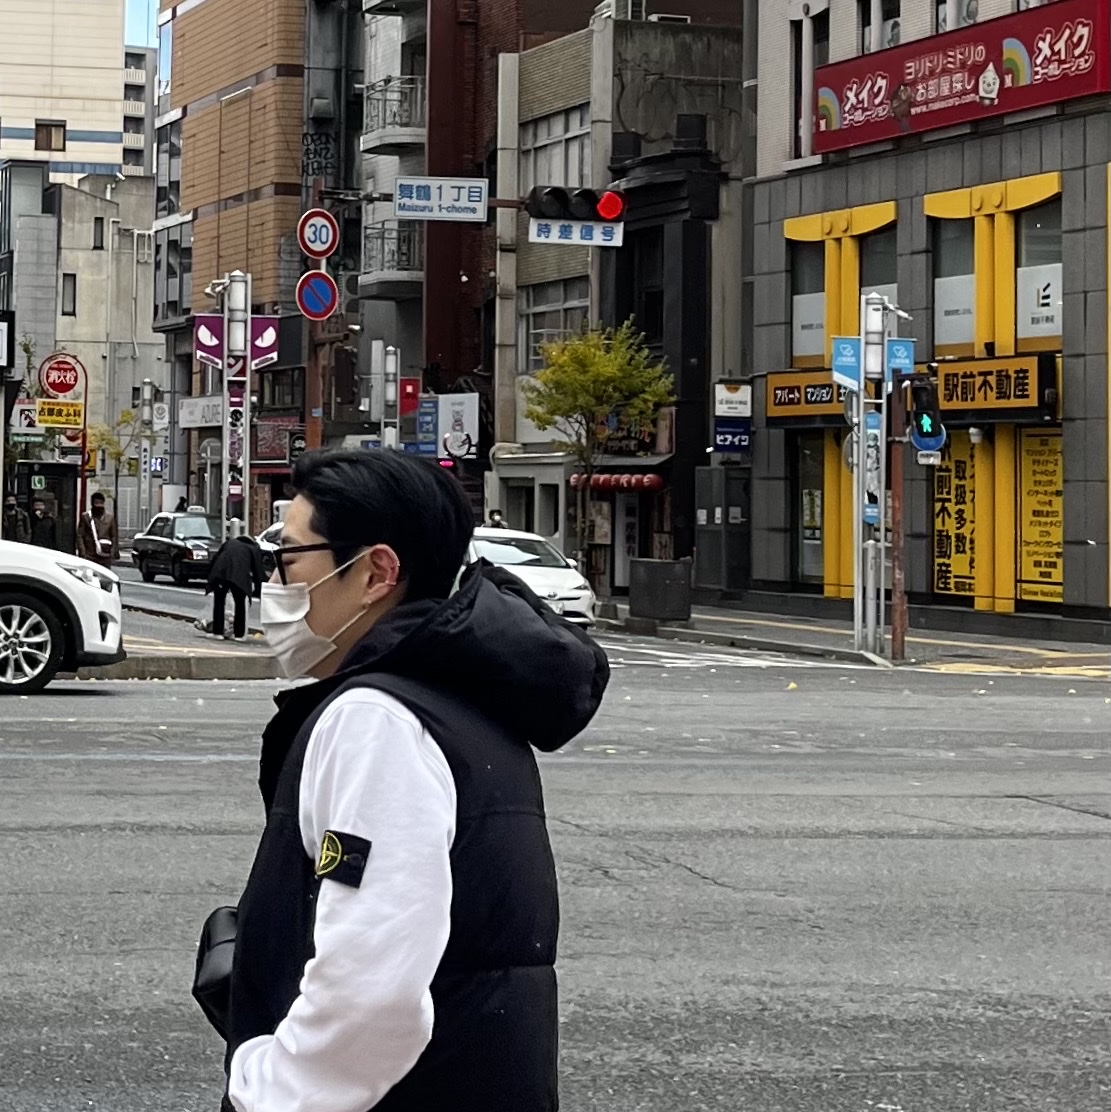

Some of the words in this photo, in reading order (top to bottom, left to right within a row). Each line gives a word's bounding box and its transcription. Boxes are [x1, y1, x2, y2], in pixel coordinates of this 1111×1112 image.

[1035, 24, 1090, 65] メイク
[843, 76, 888, 112] メイク
[397, 202, 434, 213] Maizuru
[437, 203, 478, 214] 1-chome
[307, 222, 330, 246] 30
[536, 222, 616, 242] 時差信号
[775, 388, 801, 404] アパート
[806, 386, 833, 402] マンション
[943, 368, 1030, 403] 駅前不動産
[954, 459, 968, 555] 取扱多数
